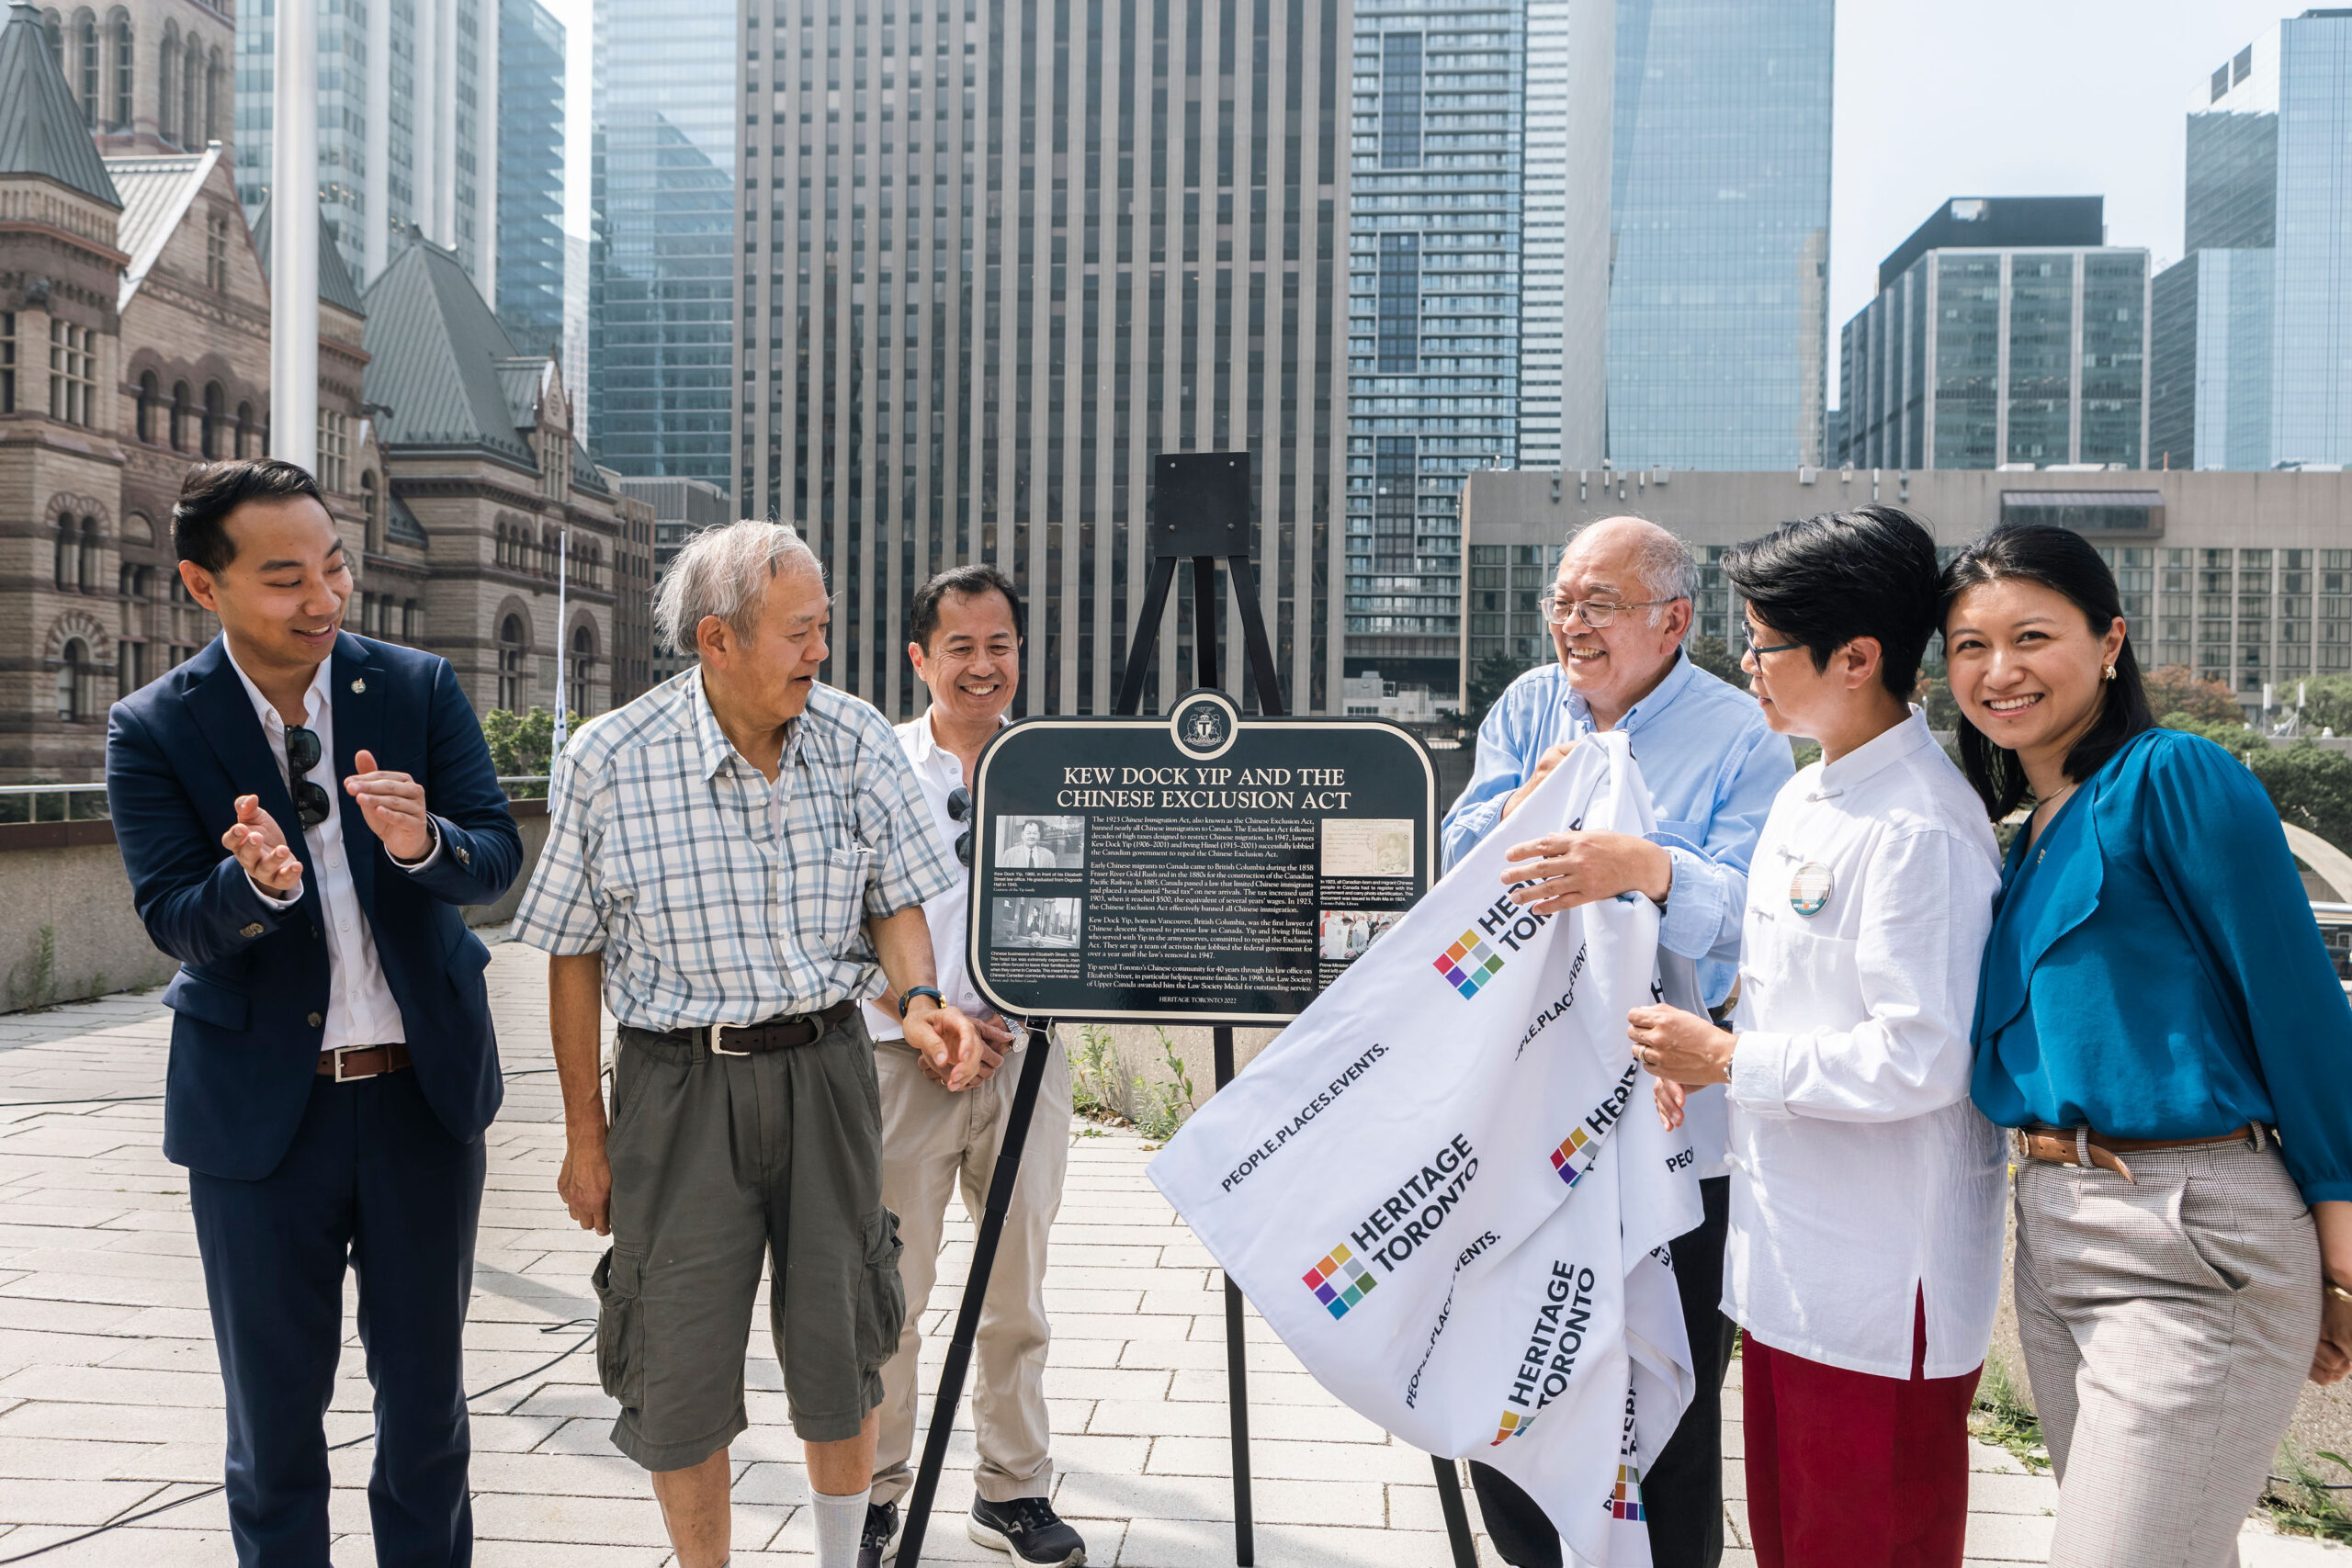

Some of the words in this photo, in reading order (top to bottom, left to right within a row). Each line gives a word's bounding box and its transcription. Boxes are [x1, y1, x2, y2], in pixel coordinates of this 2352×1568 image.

[1064, 767, 1115, 784] KEW
[1121, 767, 1190, 785] DOCK
[1195, 768, 1232, 785] YIP
[1238, 768, 1291, 785] AND
[1297, 769, 1345, 786] THE
[1057, 790, 1155, 807] CHINESE
[1161, 791, 1295, 809] EXCLUSION
[1300, 792, 1351, 809] ACT
[1144, 817, 1177, 825] Immigration
[1114, 825, 1132, 833] nearly
[1123, 833, 1136, 841] high
[1153, 833, 1179, 842] designed
[1292, 834, 1314, 843] lawyers
[1122, 841, 1132, 849] Yip
[1183, 841, 1200, 850] Irving
[1259, 842, 1291, 851] successfully
[1132, 850, 1168, 858] government
[1177, 850, 1195, 858] repeal
[1091, 862, 1105, 871] Early
[1266, 864, 1286, 872] during
[1110, 879, 1134, 887] Railway.
[1184, 880, 1203, 888] passed
[1280, 881, 1314, 889] immigrants
[1088, 964, 1097, 972] Yip
[1172, 966, 1205, 974] community
[1241, 966, 1264, 975] through
[1142, 973, 1169, 981] particular
[1171, 973, 1193, 982] helping
[1290, 975, 1313, 984] Society
[1094, 980, 1112, 989] Upper
[1201, 983, 1222, 991] Society
[1254, 984, 1289, 993] outstanding
[1221, 1043, 1389, 1192] PEOPLE.PLACES.EVENTS.
[1351, 1133, 1473, 1252] HERITAGE
[1371, 1157, 1478, 1272] TORONTO
[1508, 1260, 1575, 1407] HERITAGE
[1536, 1268, 1595, 1409] TORONTO
